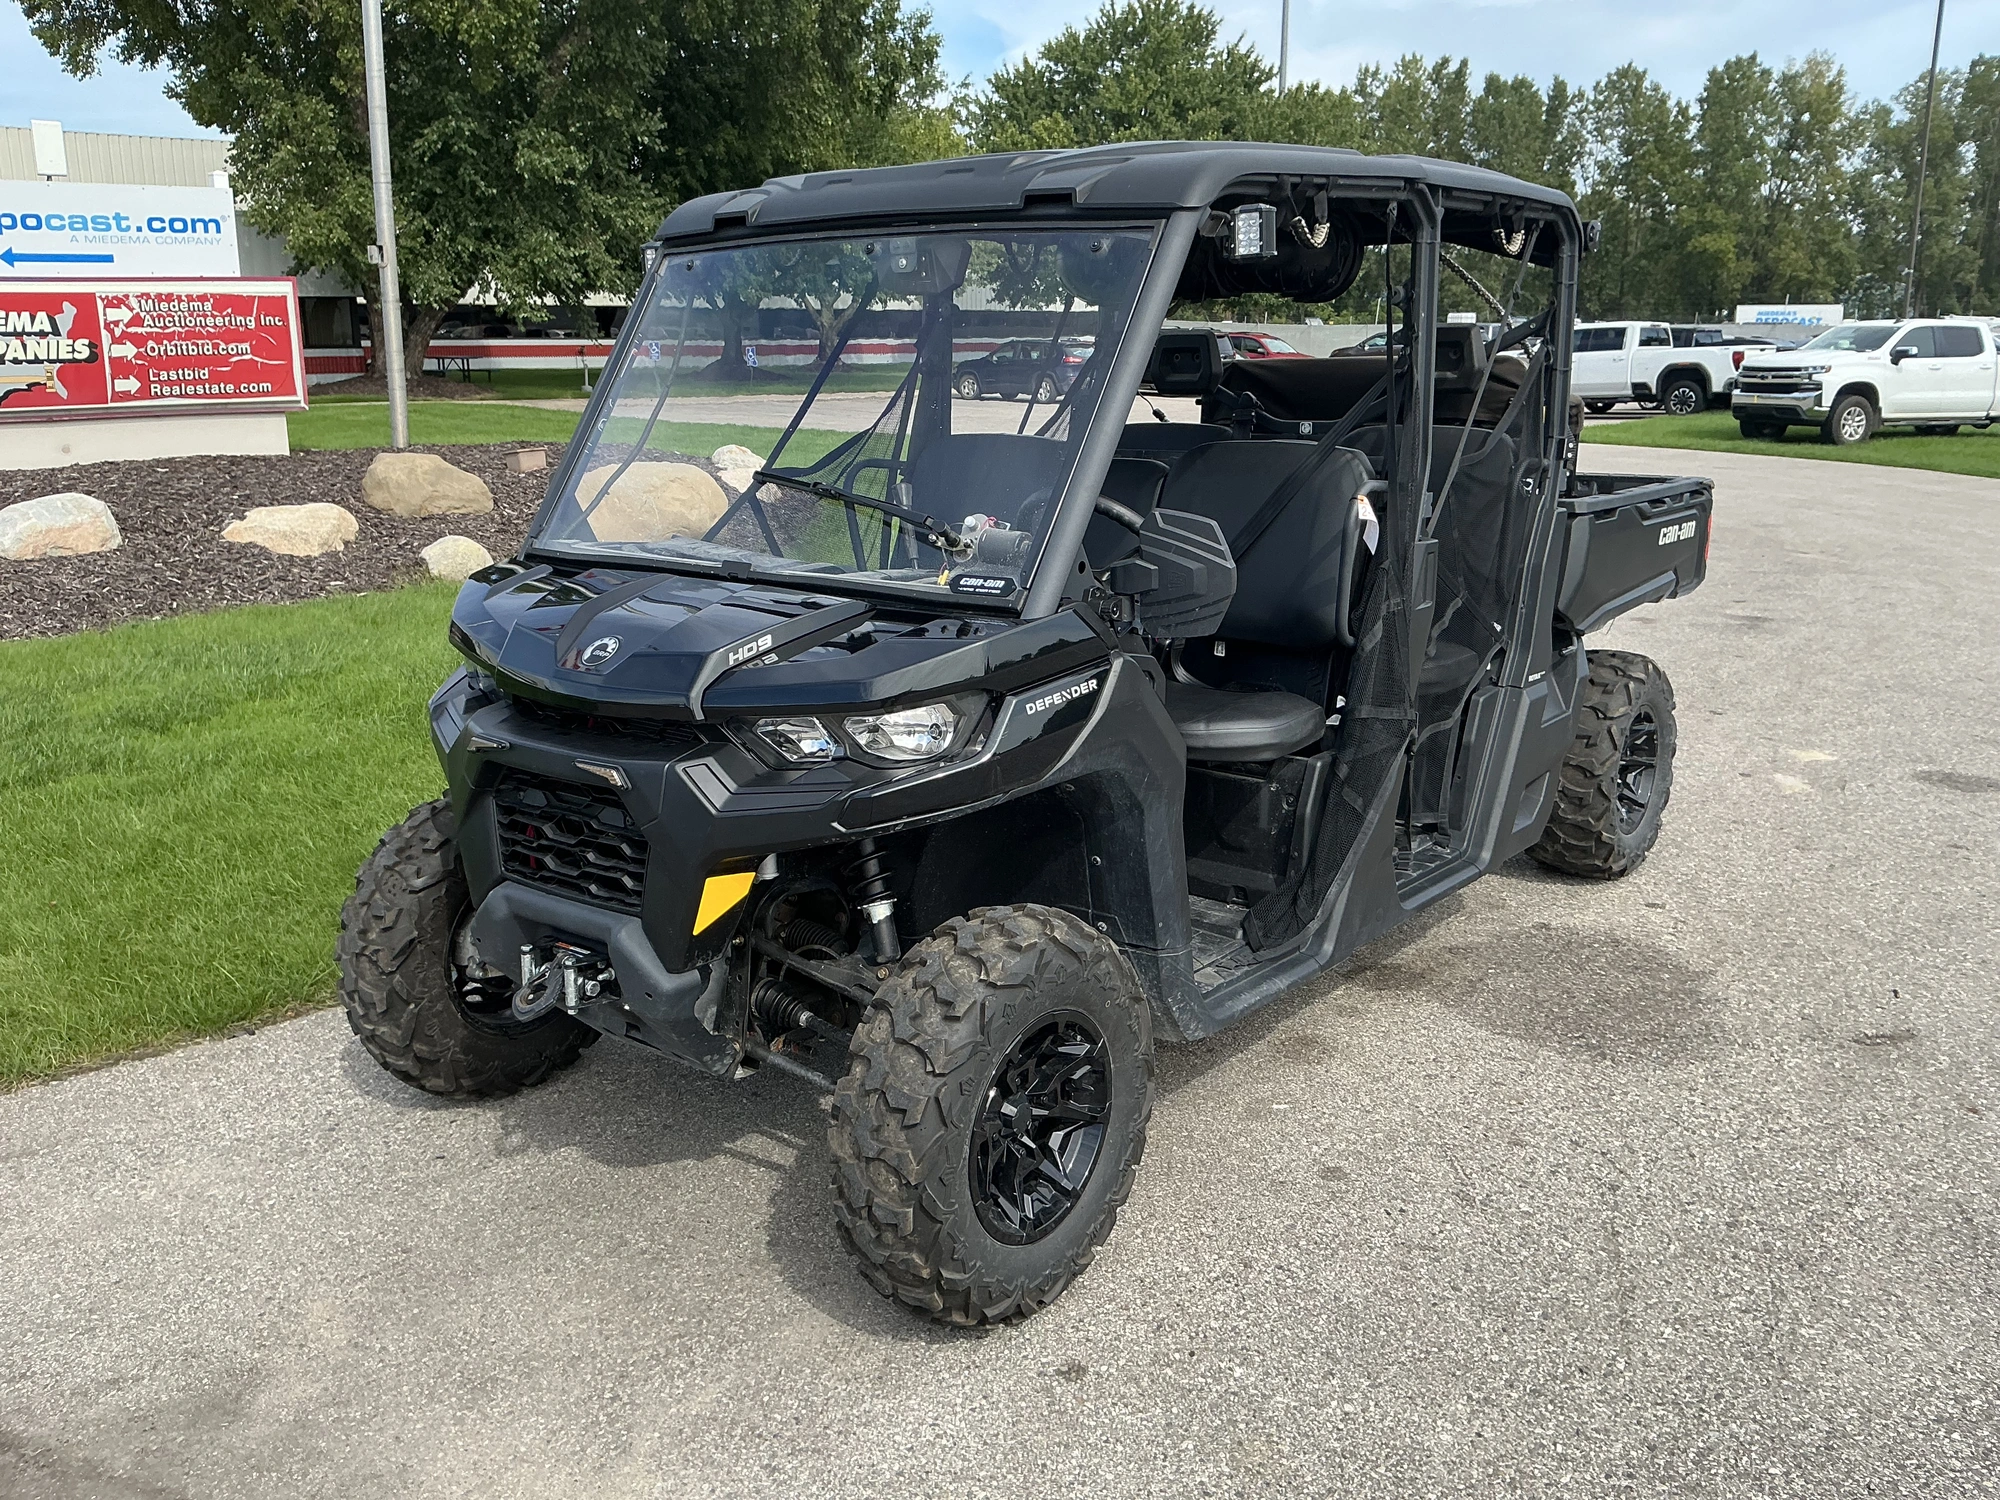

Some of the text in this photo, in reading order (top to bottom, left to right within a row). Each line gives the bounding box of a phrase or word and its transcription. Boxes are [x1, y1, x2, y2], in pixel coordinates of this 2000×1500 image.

[70, 235, 222, 245] A MIEDEMA COMPANY
[140, 299, 213, 312] Miedema
[143, 314, 287, 329] Auctioneering Inc.
[146, 342, 251, 357] Orbitbid.com
[148, 367, 209, 381] Lastbid
[150, 382, 272, 396] Realestate.com
[728, 634, 772, 666] HD9
[1025, 679, 1098, 715] DEFENDER
